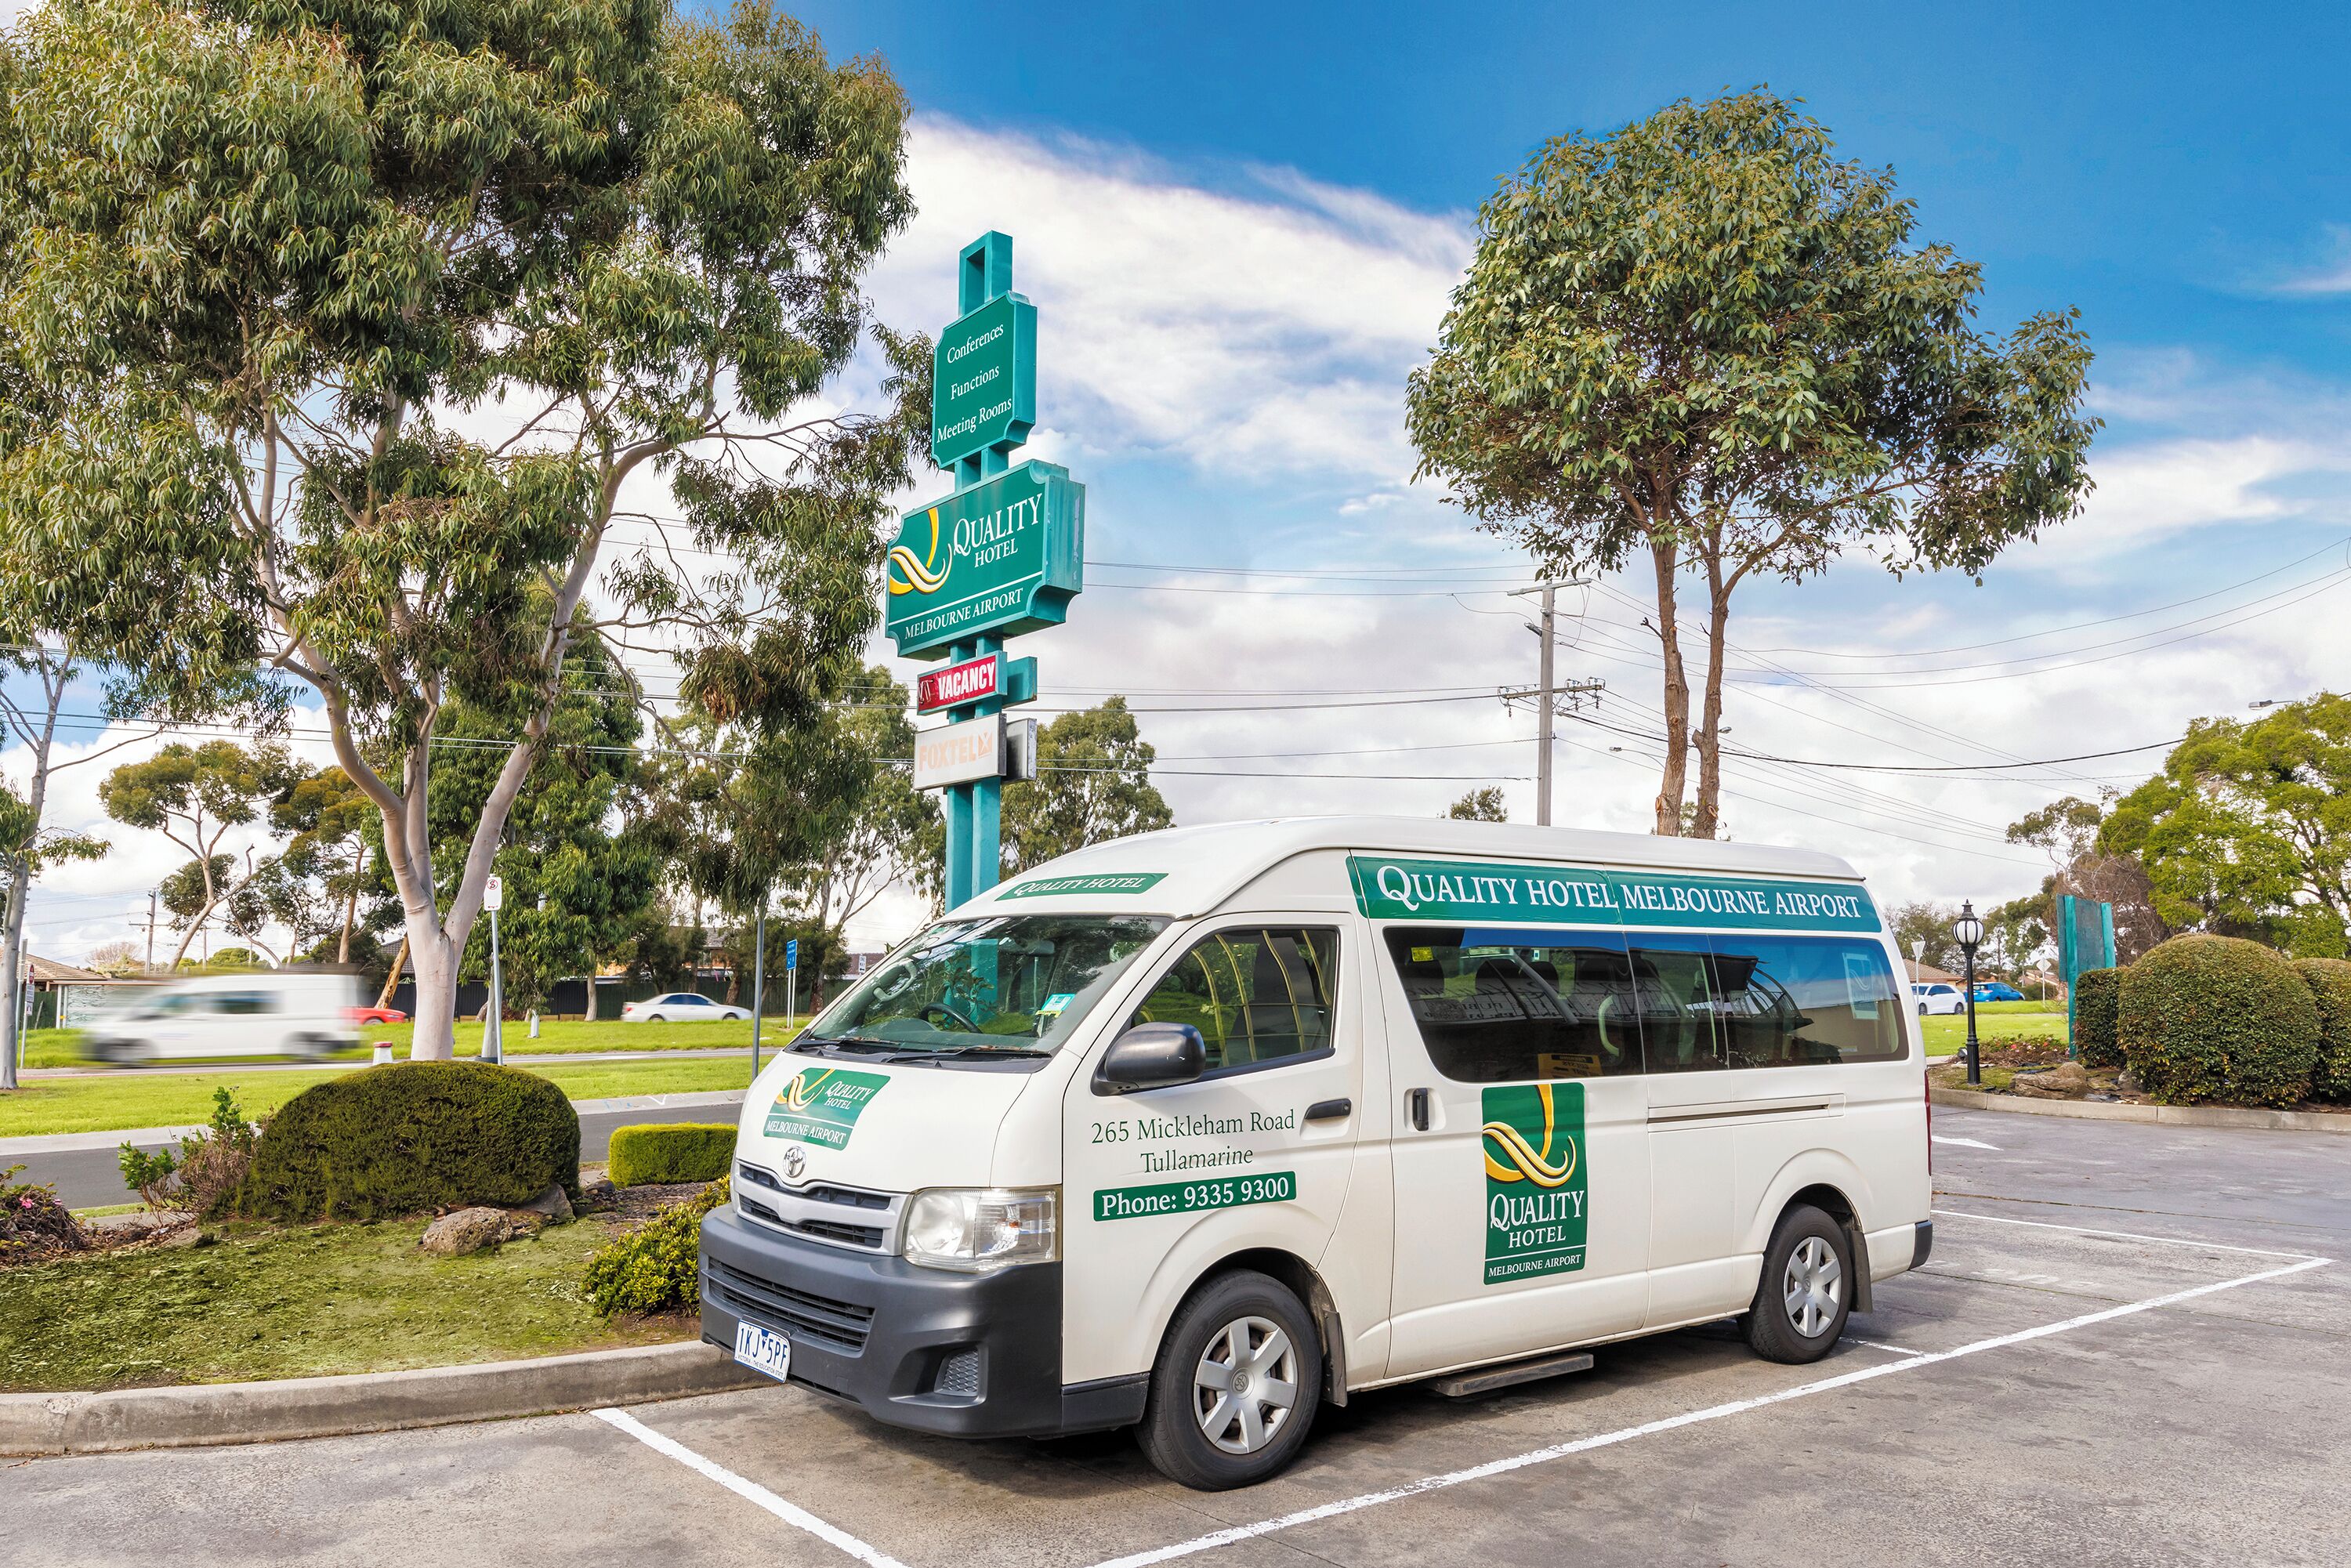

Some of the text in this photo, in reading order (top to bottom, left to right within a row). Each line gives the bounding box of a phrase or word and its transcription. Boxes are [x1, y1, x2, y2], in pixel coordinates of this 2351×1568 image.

[947, 324, 1004, 364] Conferences
[951, 365, 999, 400] Functions
[936, 398, 1012, 444] Meeting Rooms
[954, 493, 1042, 556] QUALITY
[974, 538, 1018, 568] HOTEL
[904, 588, 1023, 639] MELBOURNE AIRPORT
[938, 661, 995, 701] VACANCY
[918, 735, 976, 772] FOXTEL
[1013, 877, 1146, 896] QUALITY HOTEL
[1377, 865, 1861, 918] QUALITY HOTEL MELBOURNE AIRPORT
[824, 1098, 852, 1110] HOTEL
[825, 1081, 875, 1101] QUALITY
[766, 1121, 846, 1144] MELBOURNE AIRPORT
[1091, 1109, 1295, 1144] 265 Mickleham Road
[1140, 1146, 1253, 1173] Tullamarine
[1101, 1177, 1289, 1217] Phone: 9335 9300
[1491, 1190, 1584, 1231] QUALITY
[1508, 1226, 1566, 1248] HOTEL
[1488, 1254, 1581, 1277] MELBOURNE AIRPORT
